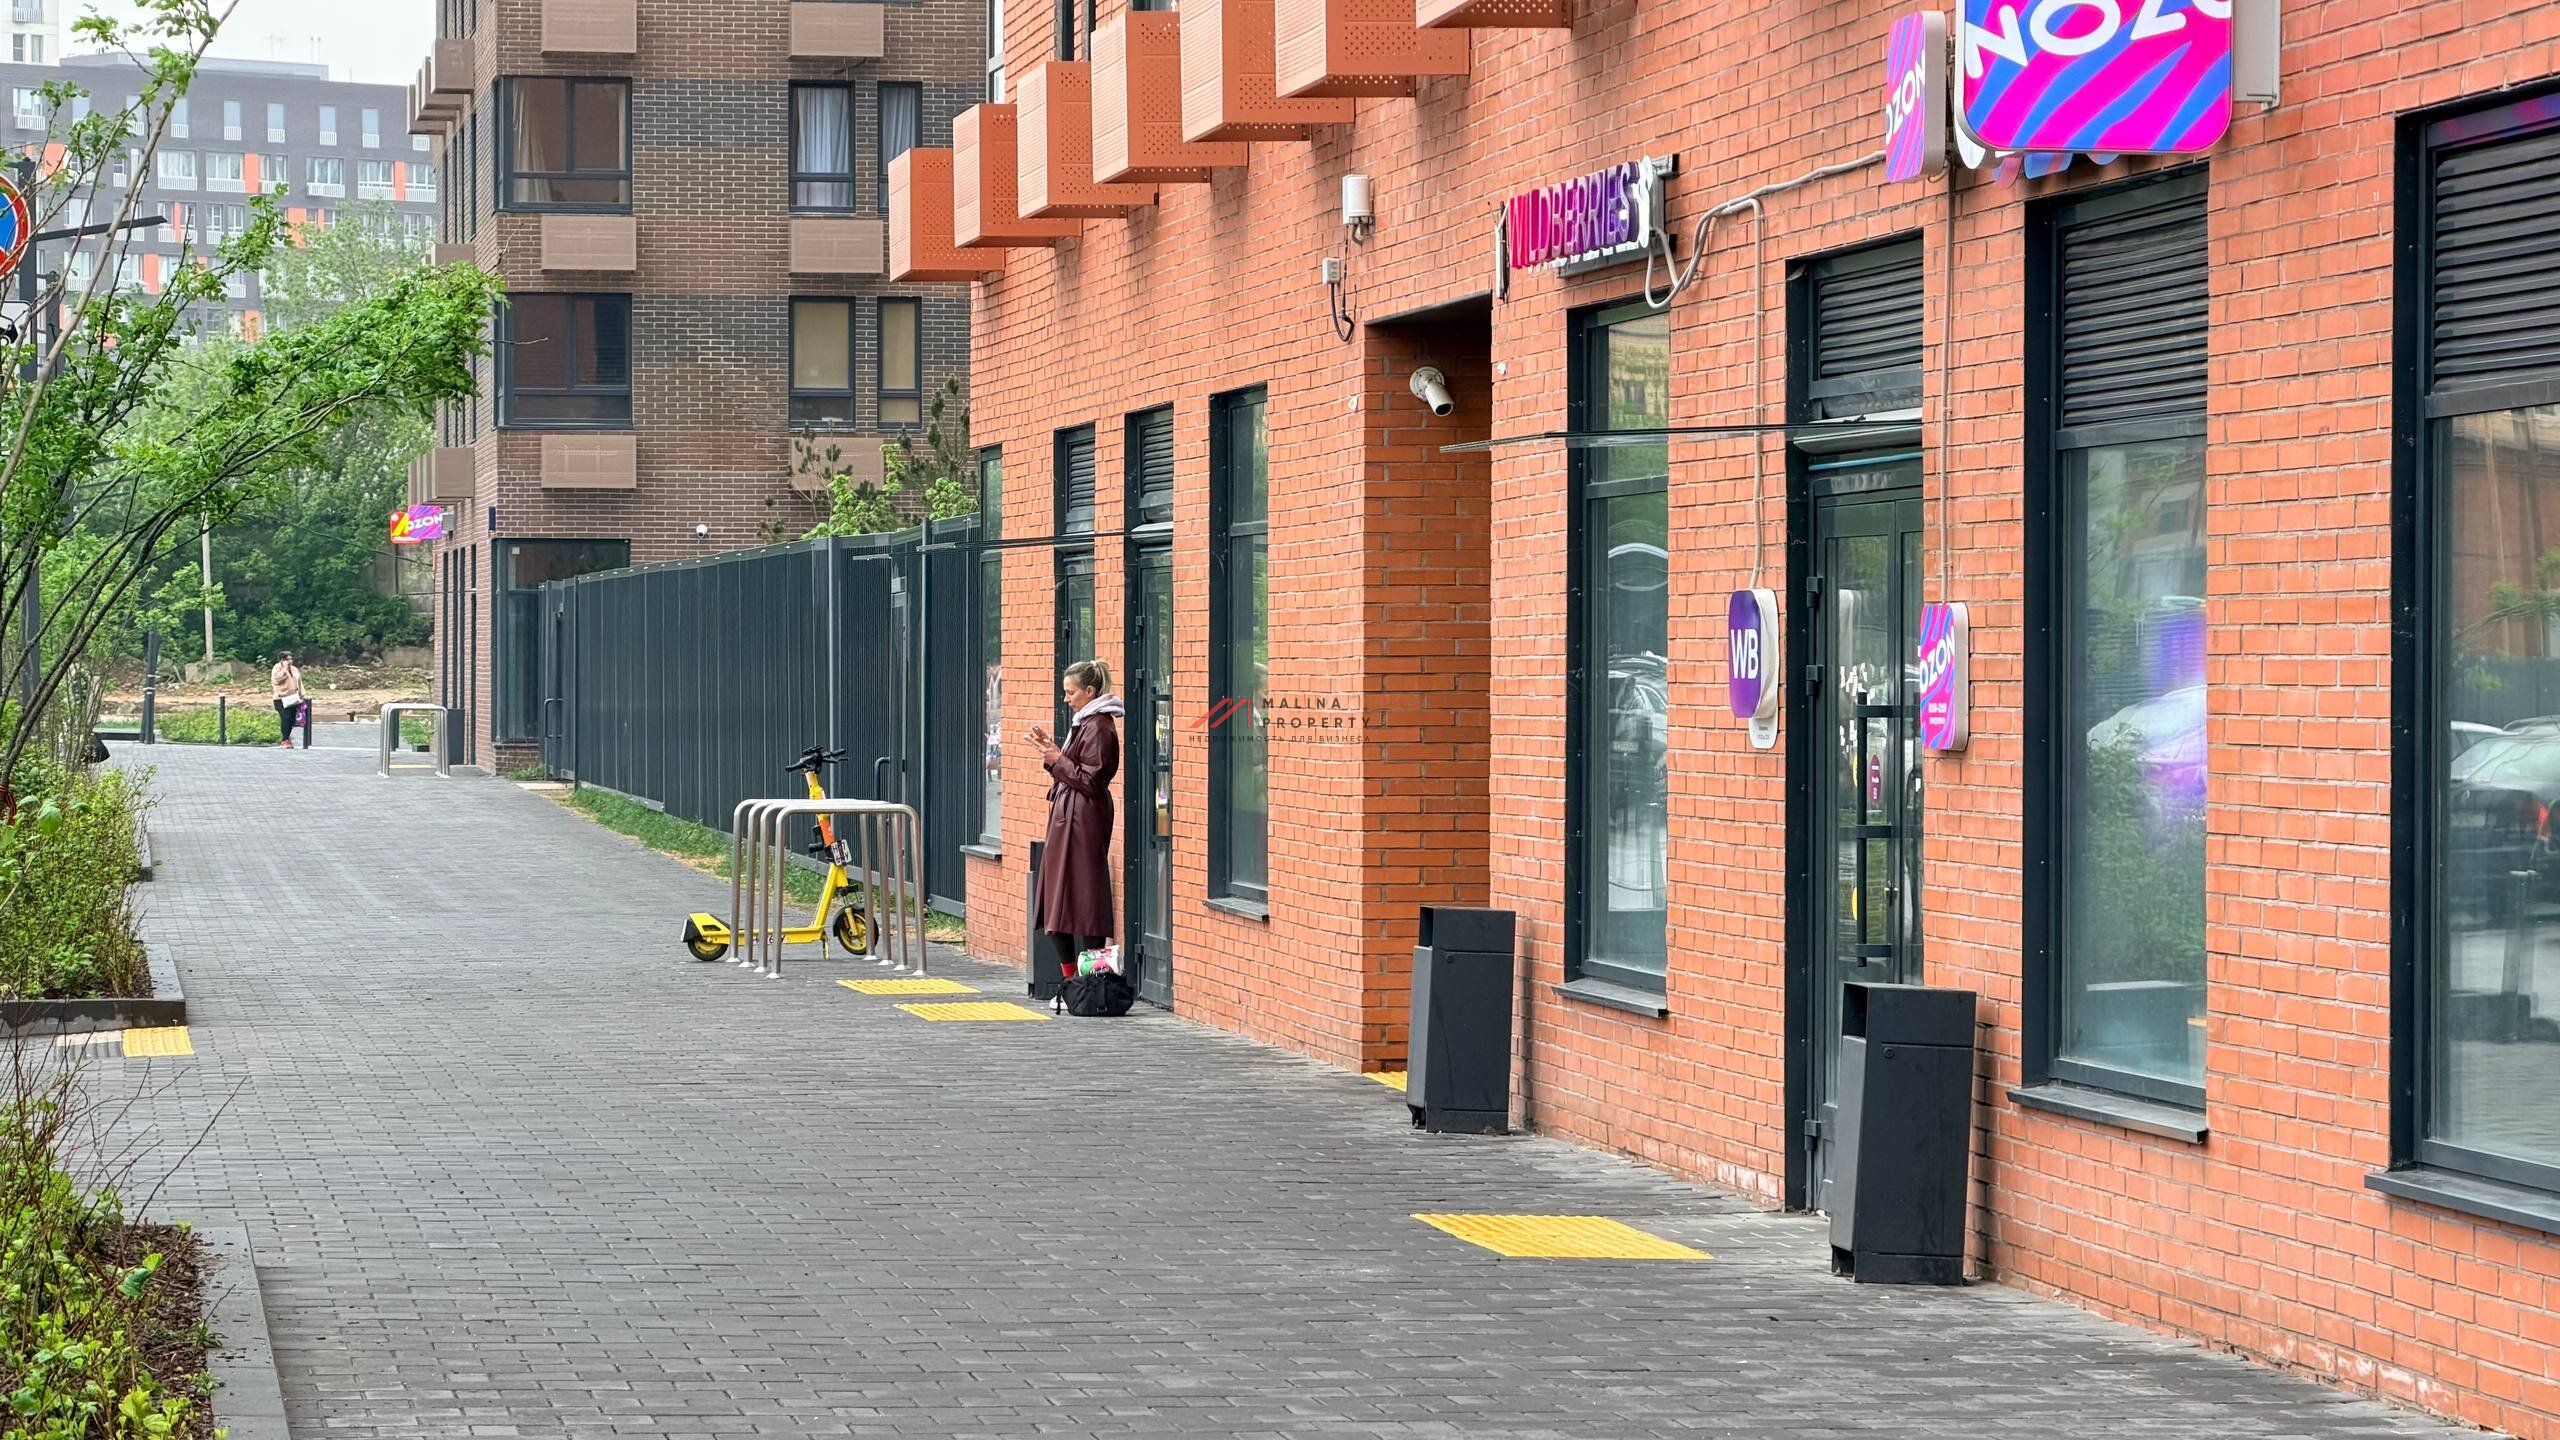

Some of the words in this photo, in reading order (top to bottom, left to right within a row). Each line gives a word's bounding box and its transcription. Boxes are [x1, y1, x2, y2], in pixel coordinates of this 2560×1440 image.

[1508, 158, 1642, 268] WILDBERRIES
[1731, 629, 1759, 679] WB
[1920, 626, 1955, 693] OZON
